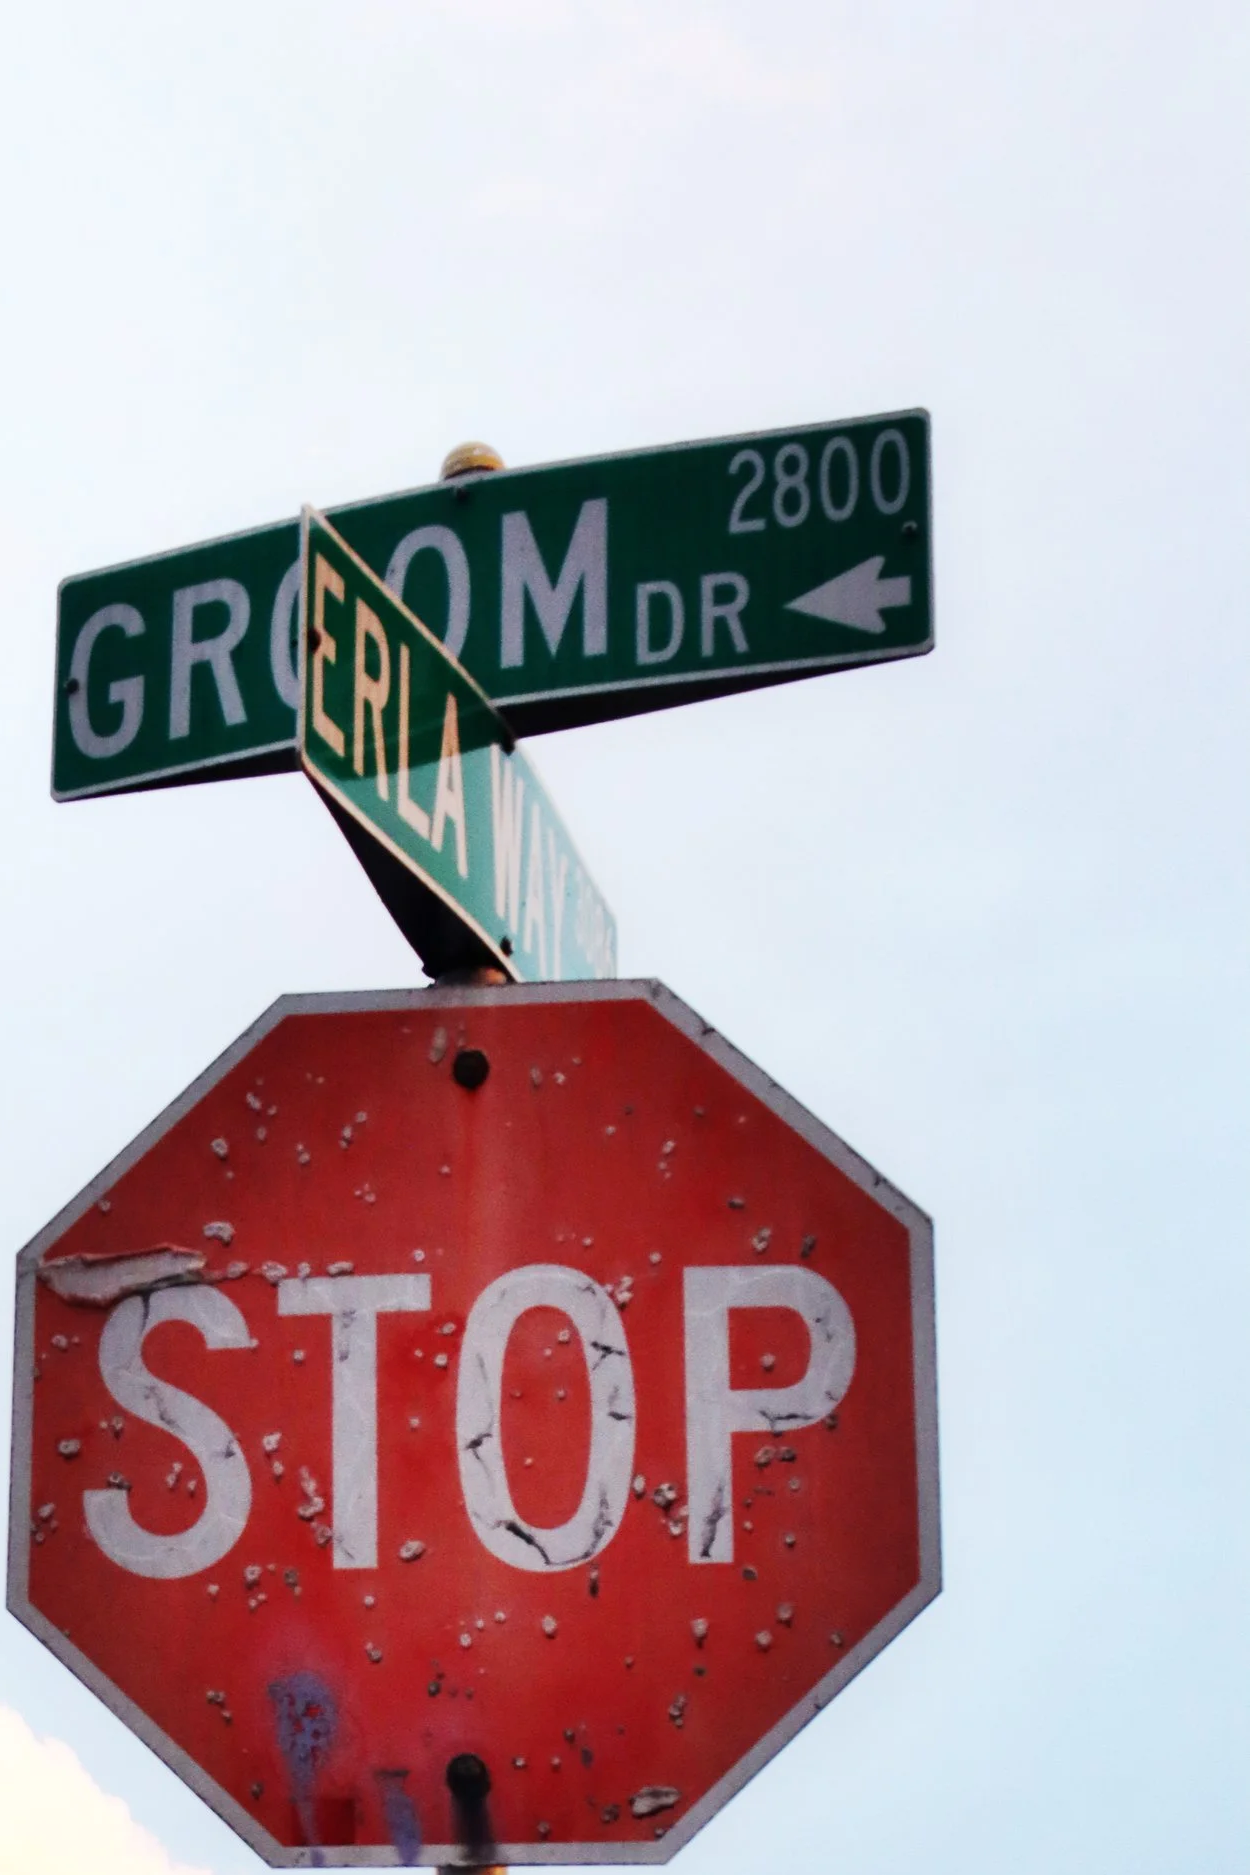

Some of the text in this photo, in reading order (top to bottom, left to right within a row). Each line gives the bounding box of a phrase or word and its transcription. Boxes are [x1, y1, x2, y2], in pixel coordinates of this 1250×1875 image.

[727, 428, 911, 534] 2800
[635, 571, 750, 666] DR
[312, 551, 569, 982] ERLA WAY
[82, 1263, 857, 1580] STOP
